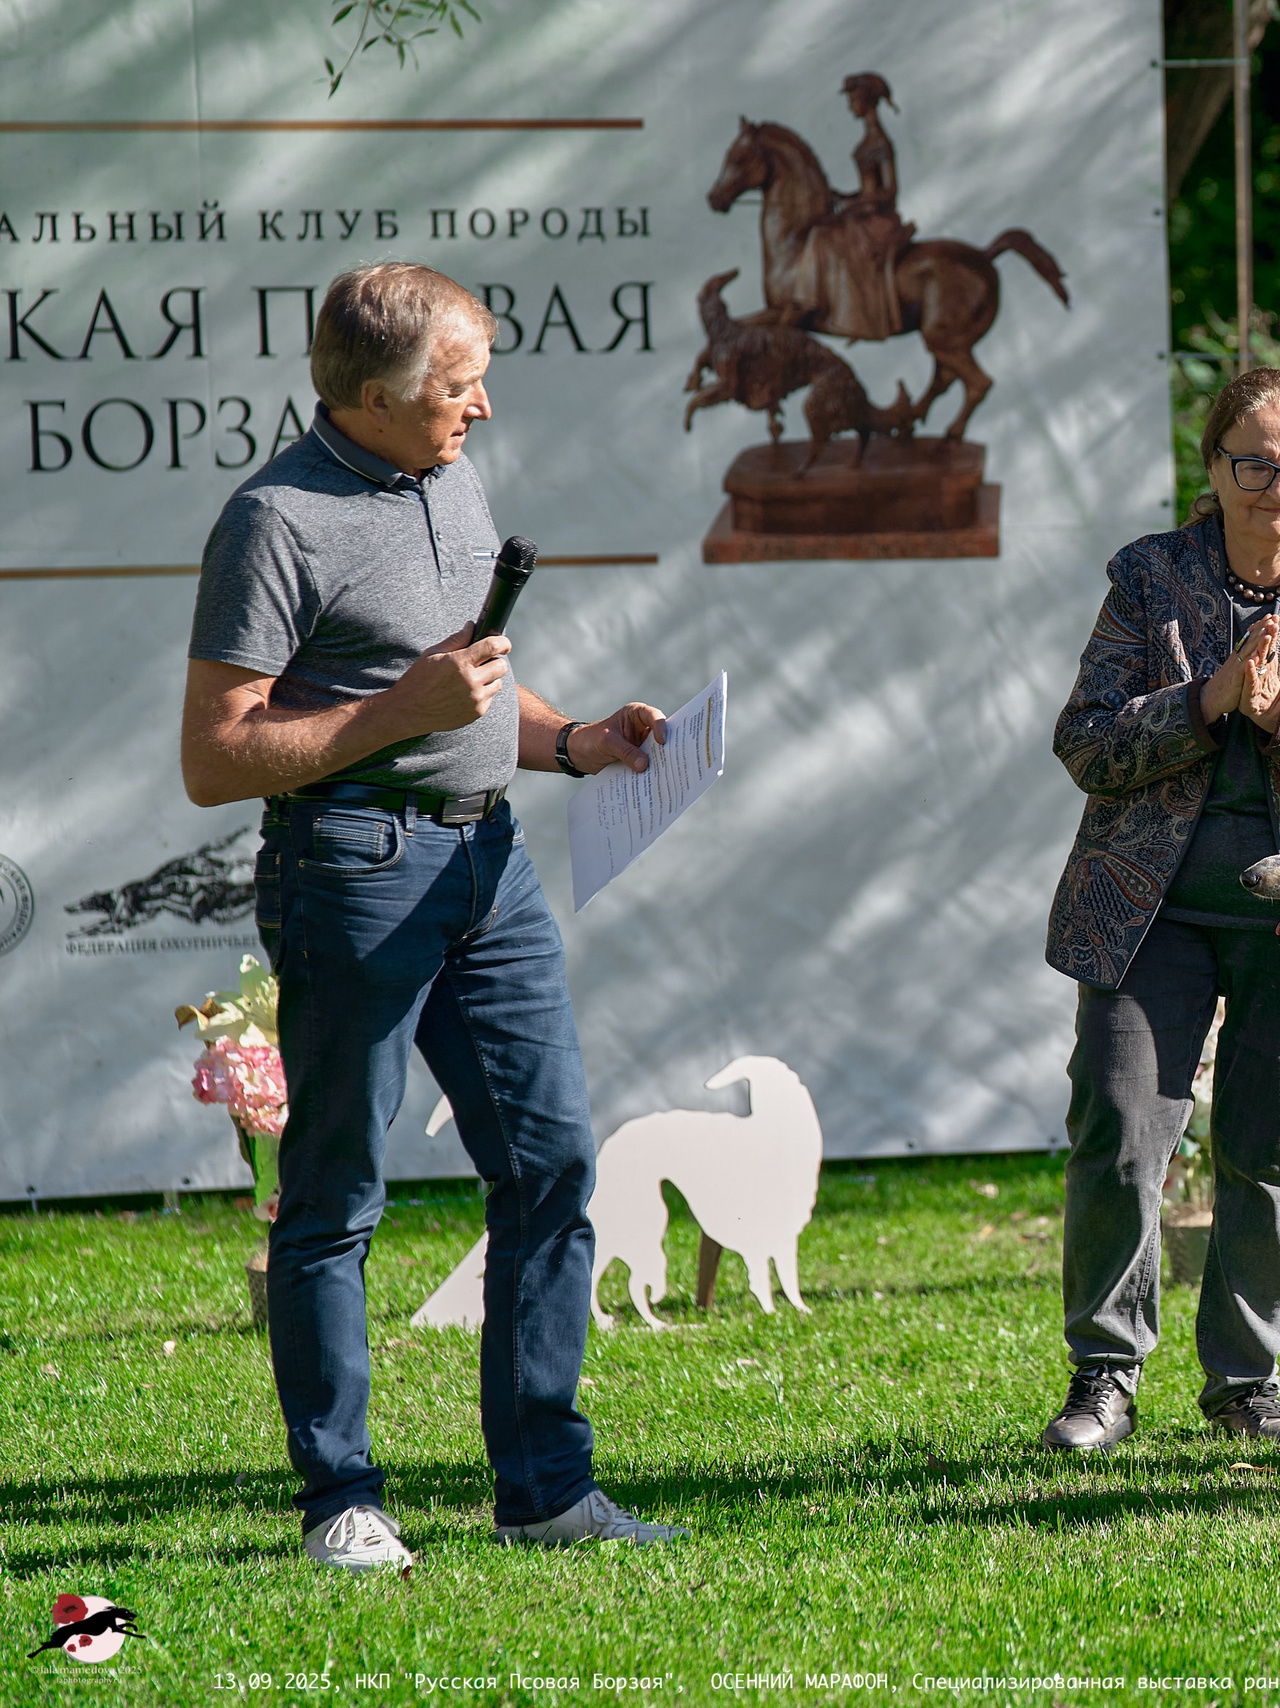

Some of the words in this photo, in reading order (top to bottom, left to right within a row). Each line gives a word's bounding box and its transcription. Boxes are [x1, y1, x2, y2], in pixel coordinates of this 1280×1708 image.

[258, 208, 399, 241] КЛУБ
[430, 206, 652, 246] ПОРОДЫ
[2, 287, 208, 362] КАЯ
[252, 280, 658, 360] ПВАЯ
[24, 395, 308, 473] БОРЗА
